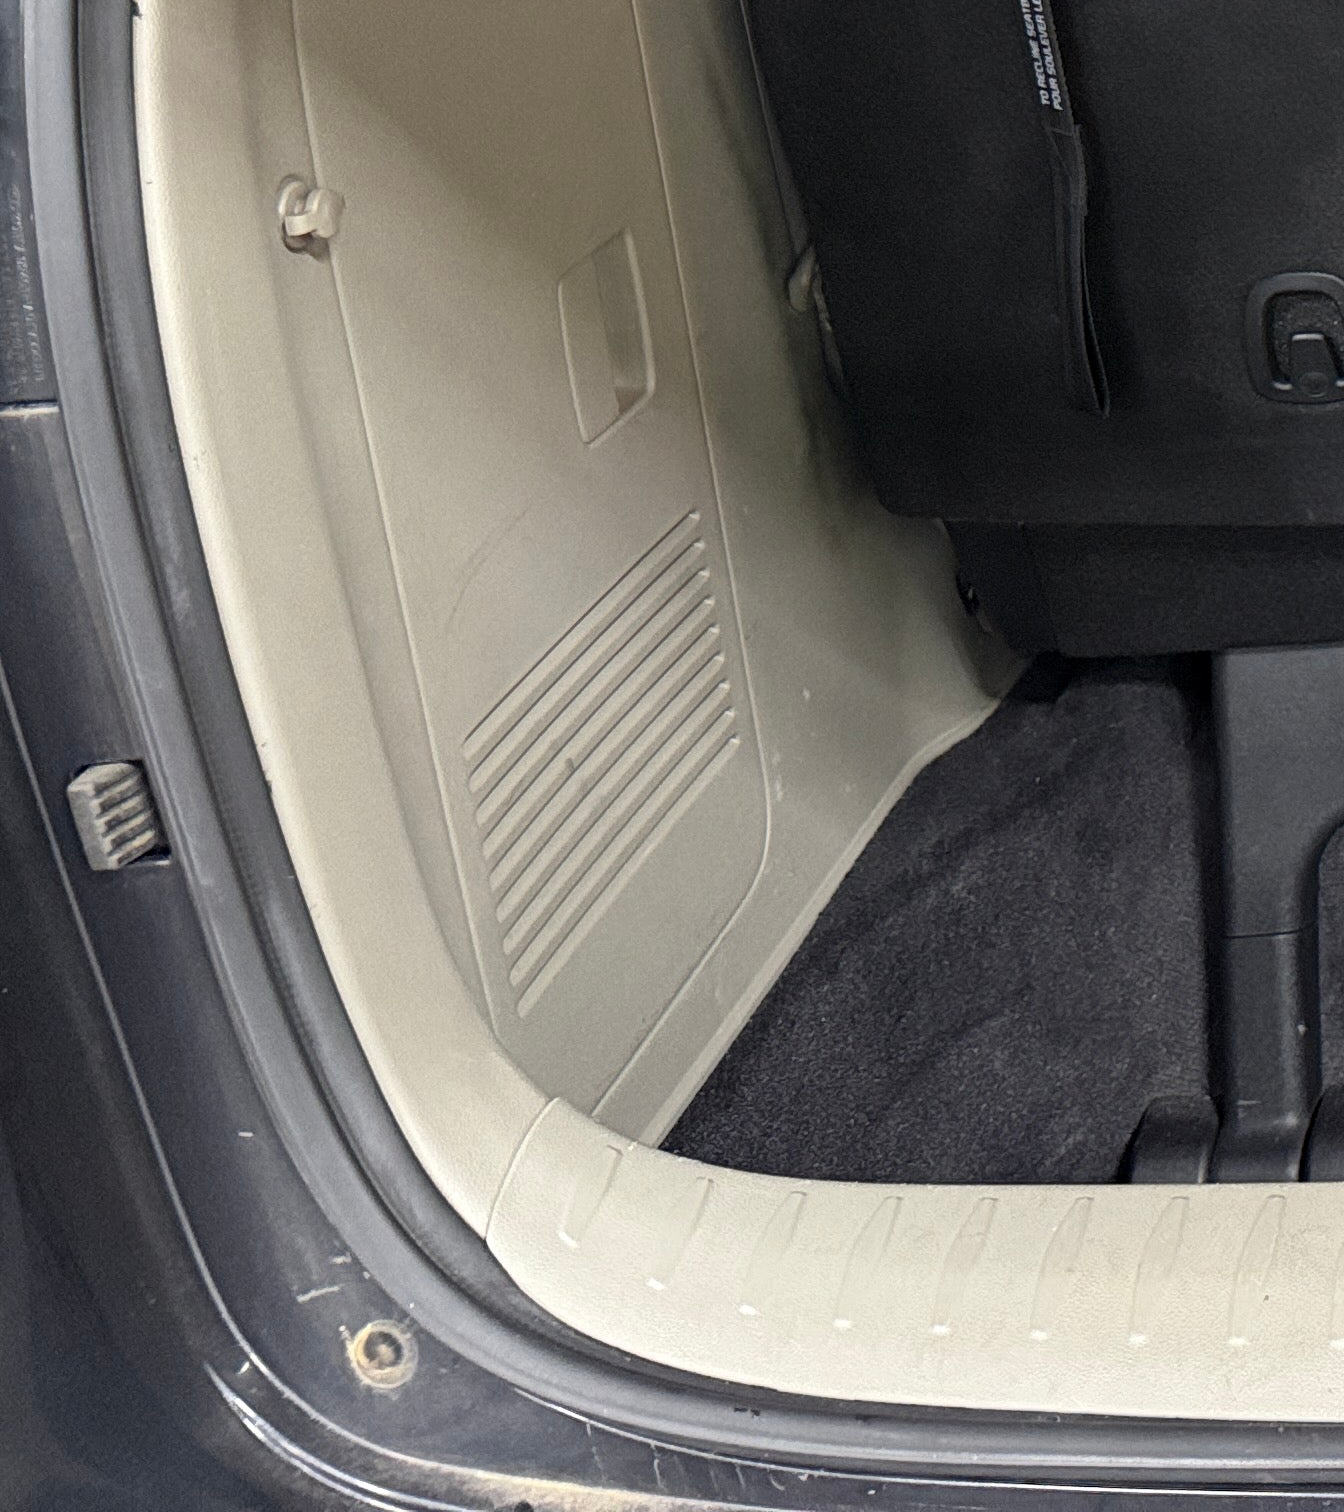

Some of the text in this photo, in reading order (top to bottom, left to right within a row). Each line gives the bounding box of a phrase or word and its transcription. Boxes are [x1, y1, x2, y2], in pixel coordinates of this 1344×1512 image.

[1029, 40, 1046, 88] RECLINE
[1035, 14, 1056, 90] SOULEVER
[1039, 89, 1050, 106] TO
[1050, 90, 1063, 111] POUR
